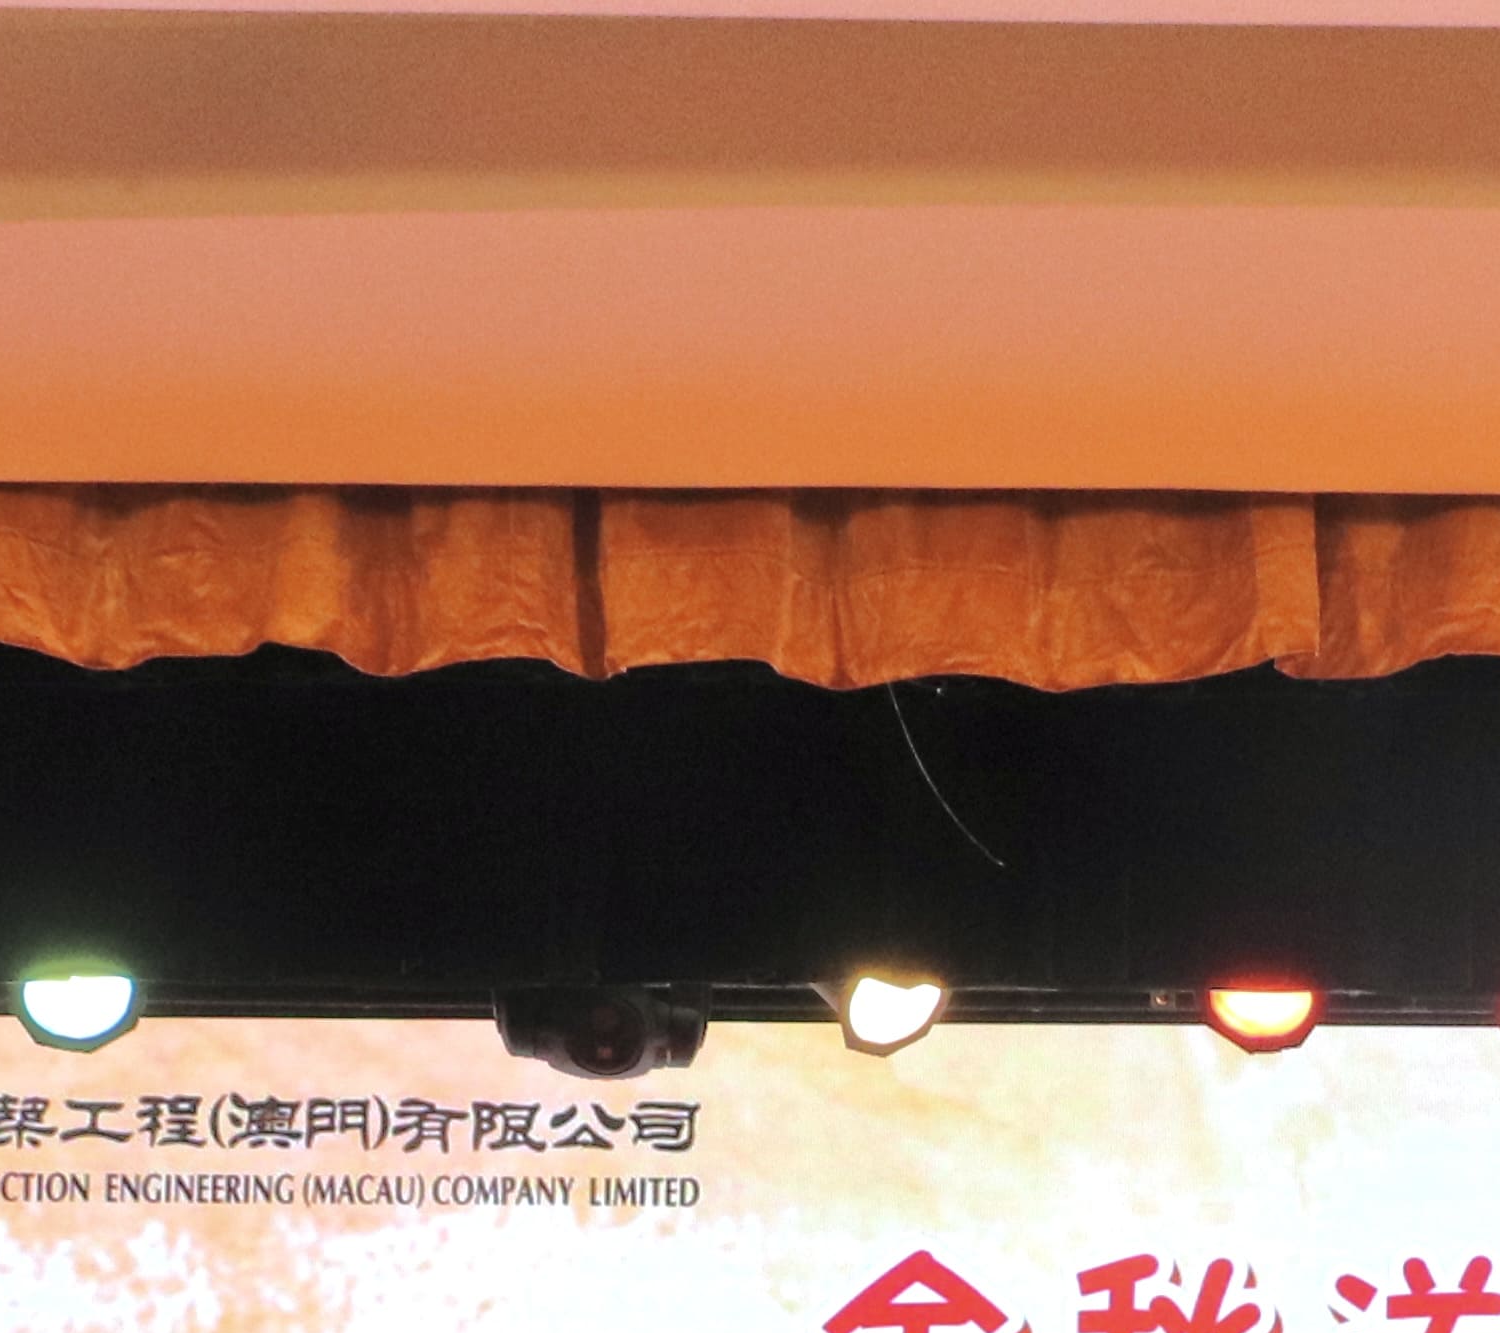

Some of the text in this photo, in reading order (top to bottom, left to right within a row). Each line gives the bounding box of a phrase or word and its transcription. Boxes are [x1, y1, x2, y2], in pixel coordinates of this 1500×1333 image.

[104, 1172, 293, 1204] ENGINEERING
[303, 1172, 425, 1208] (MACAU)
[431, 1174, 574, 1206] COMPANY
[589, 1176, 700, 1207] LIMITED
